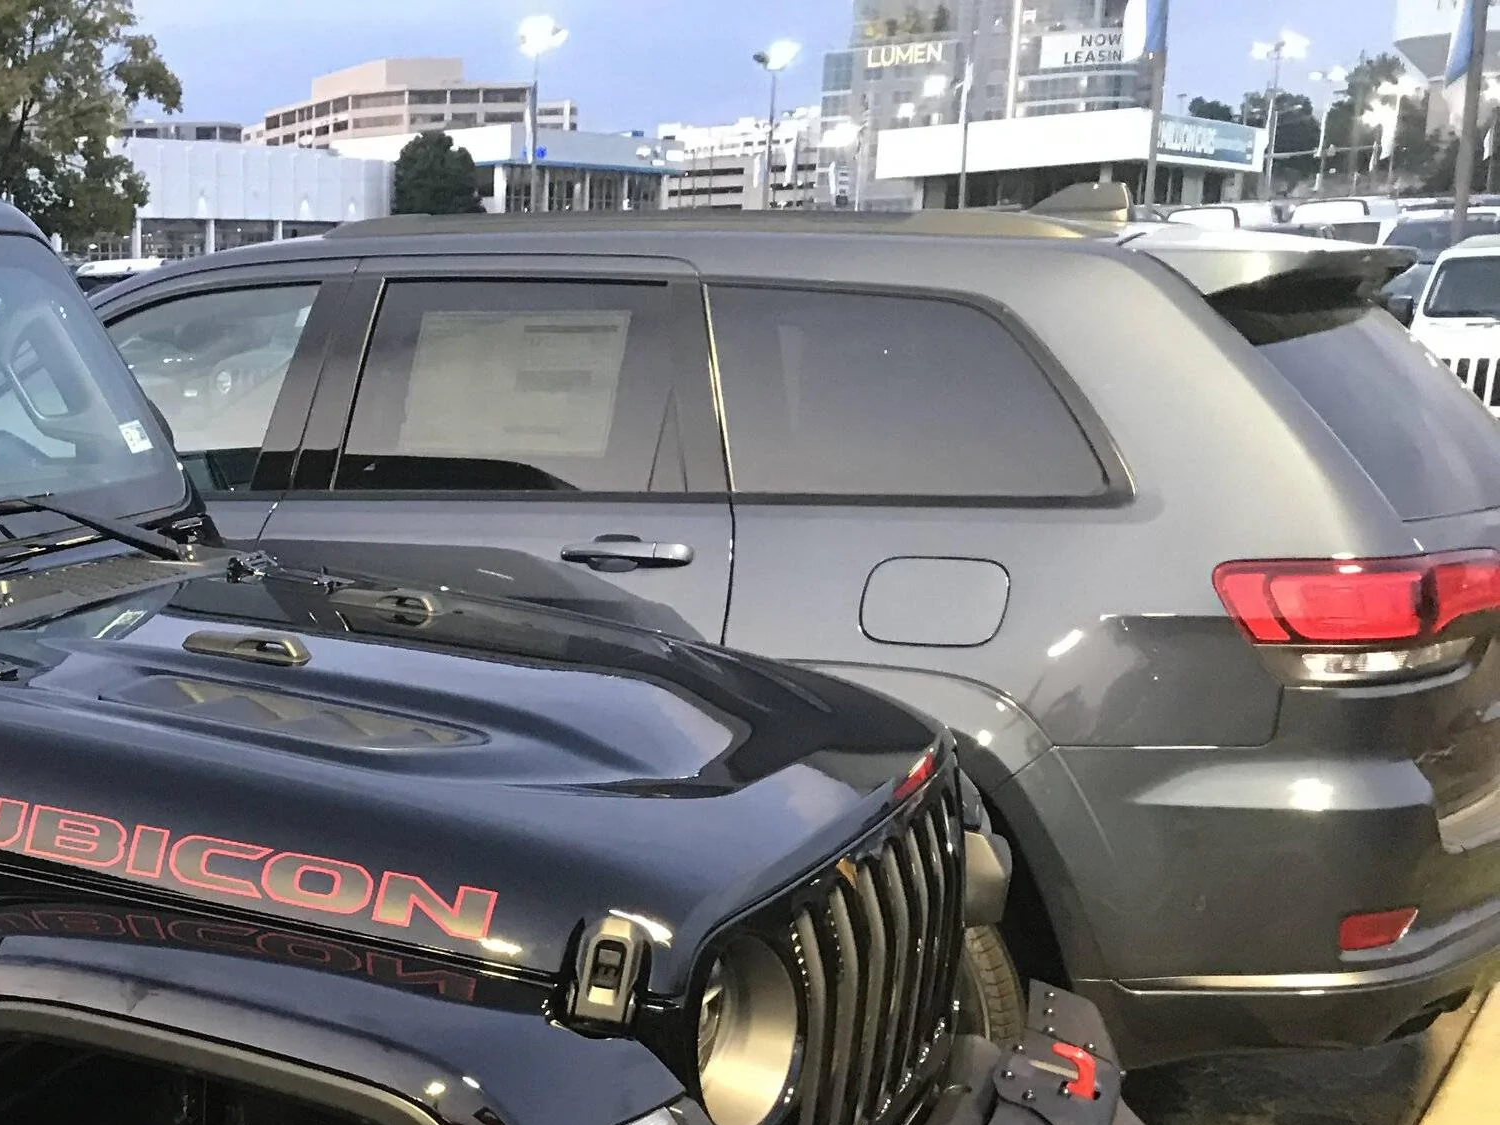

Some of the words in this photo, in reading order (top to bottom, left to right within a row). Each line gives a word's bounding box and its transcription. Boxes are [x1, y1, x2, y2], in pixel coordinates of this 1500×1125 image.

[1080, 33, 1123, 47] NOW
[867, 42, 943, 68] LUMEN
[1064, 49, 1123, 65] LEASIN
